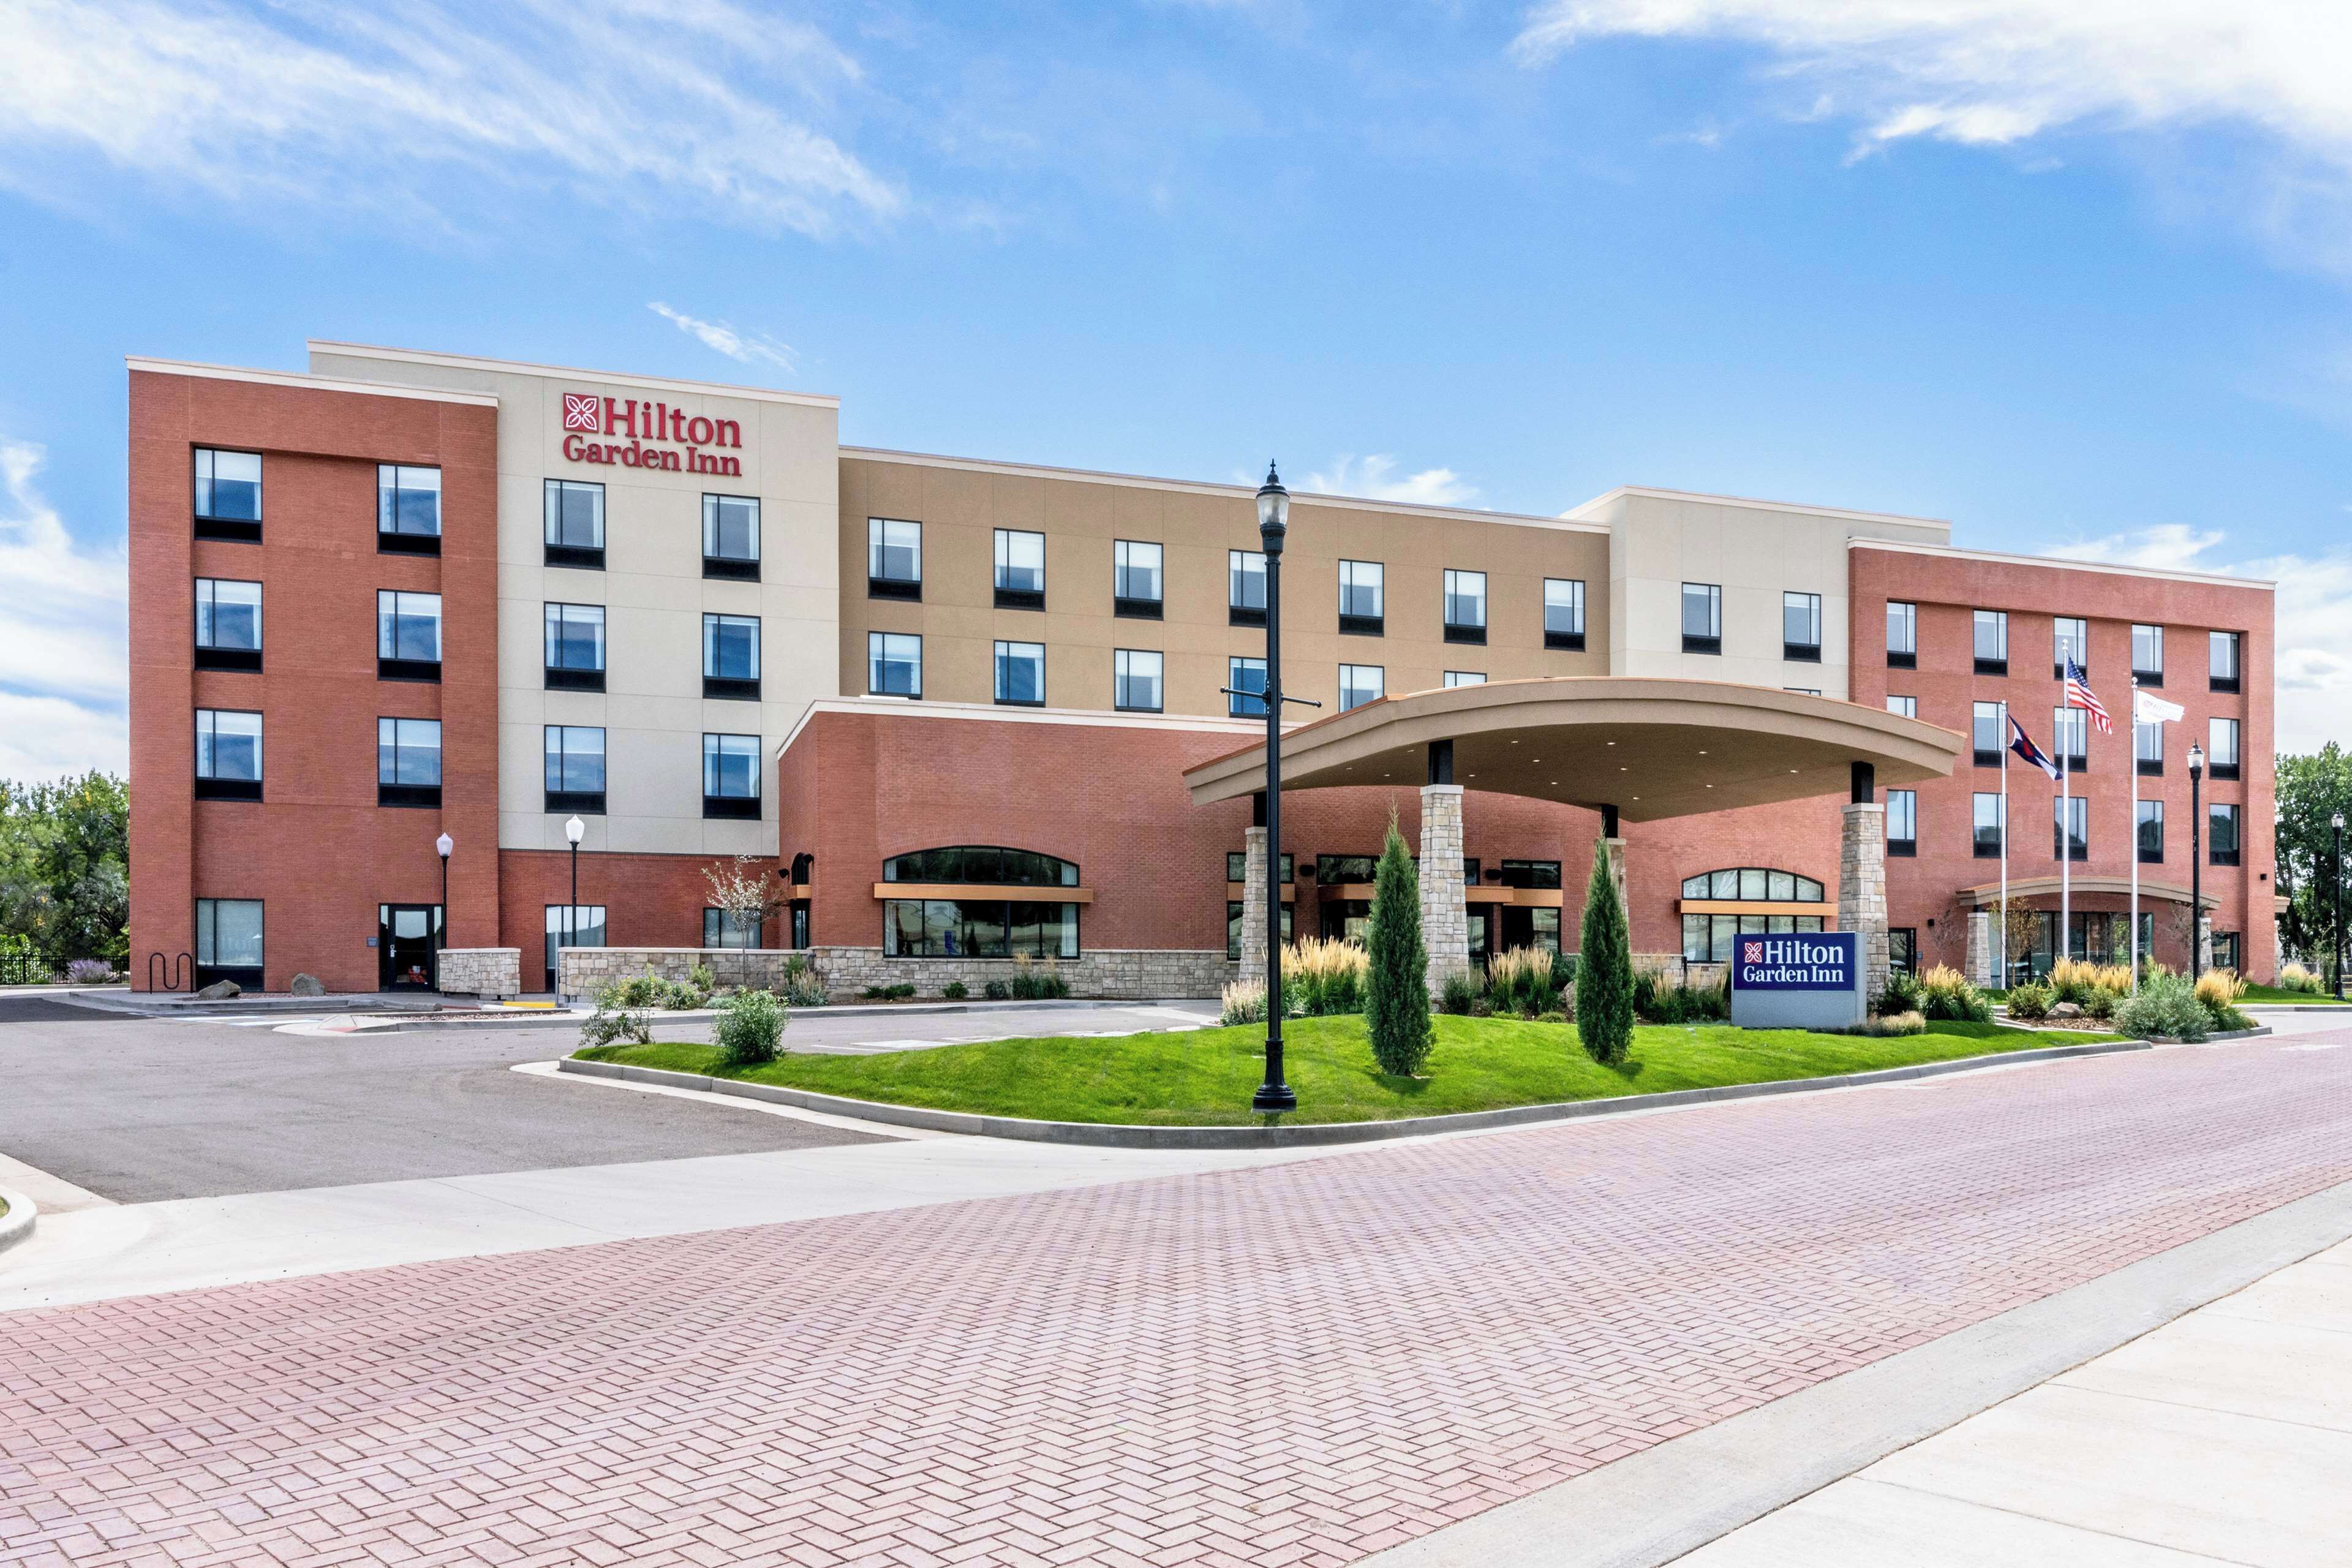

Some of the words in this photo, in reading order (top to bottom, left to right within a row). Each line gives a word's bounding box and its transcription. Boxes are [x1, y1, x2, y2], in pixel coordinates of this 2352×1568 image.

[603, 397, 742, 448] Hilton
[562, 434, 682, 472] Garden
[686, 446, 742, 477] Inn
[1765, 941, 1844, 964] Hilton
[1743, 965, 1809, 982] Garden
[1811, 965, 1844, 982] Inn
